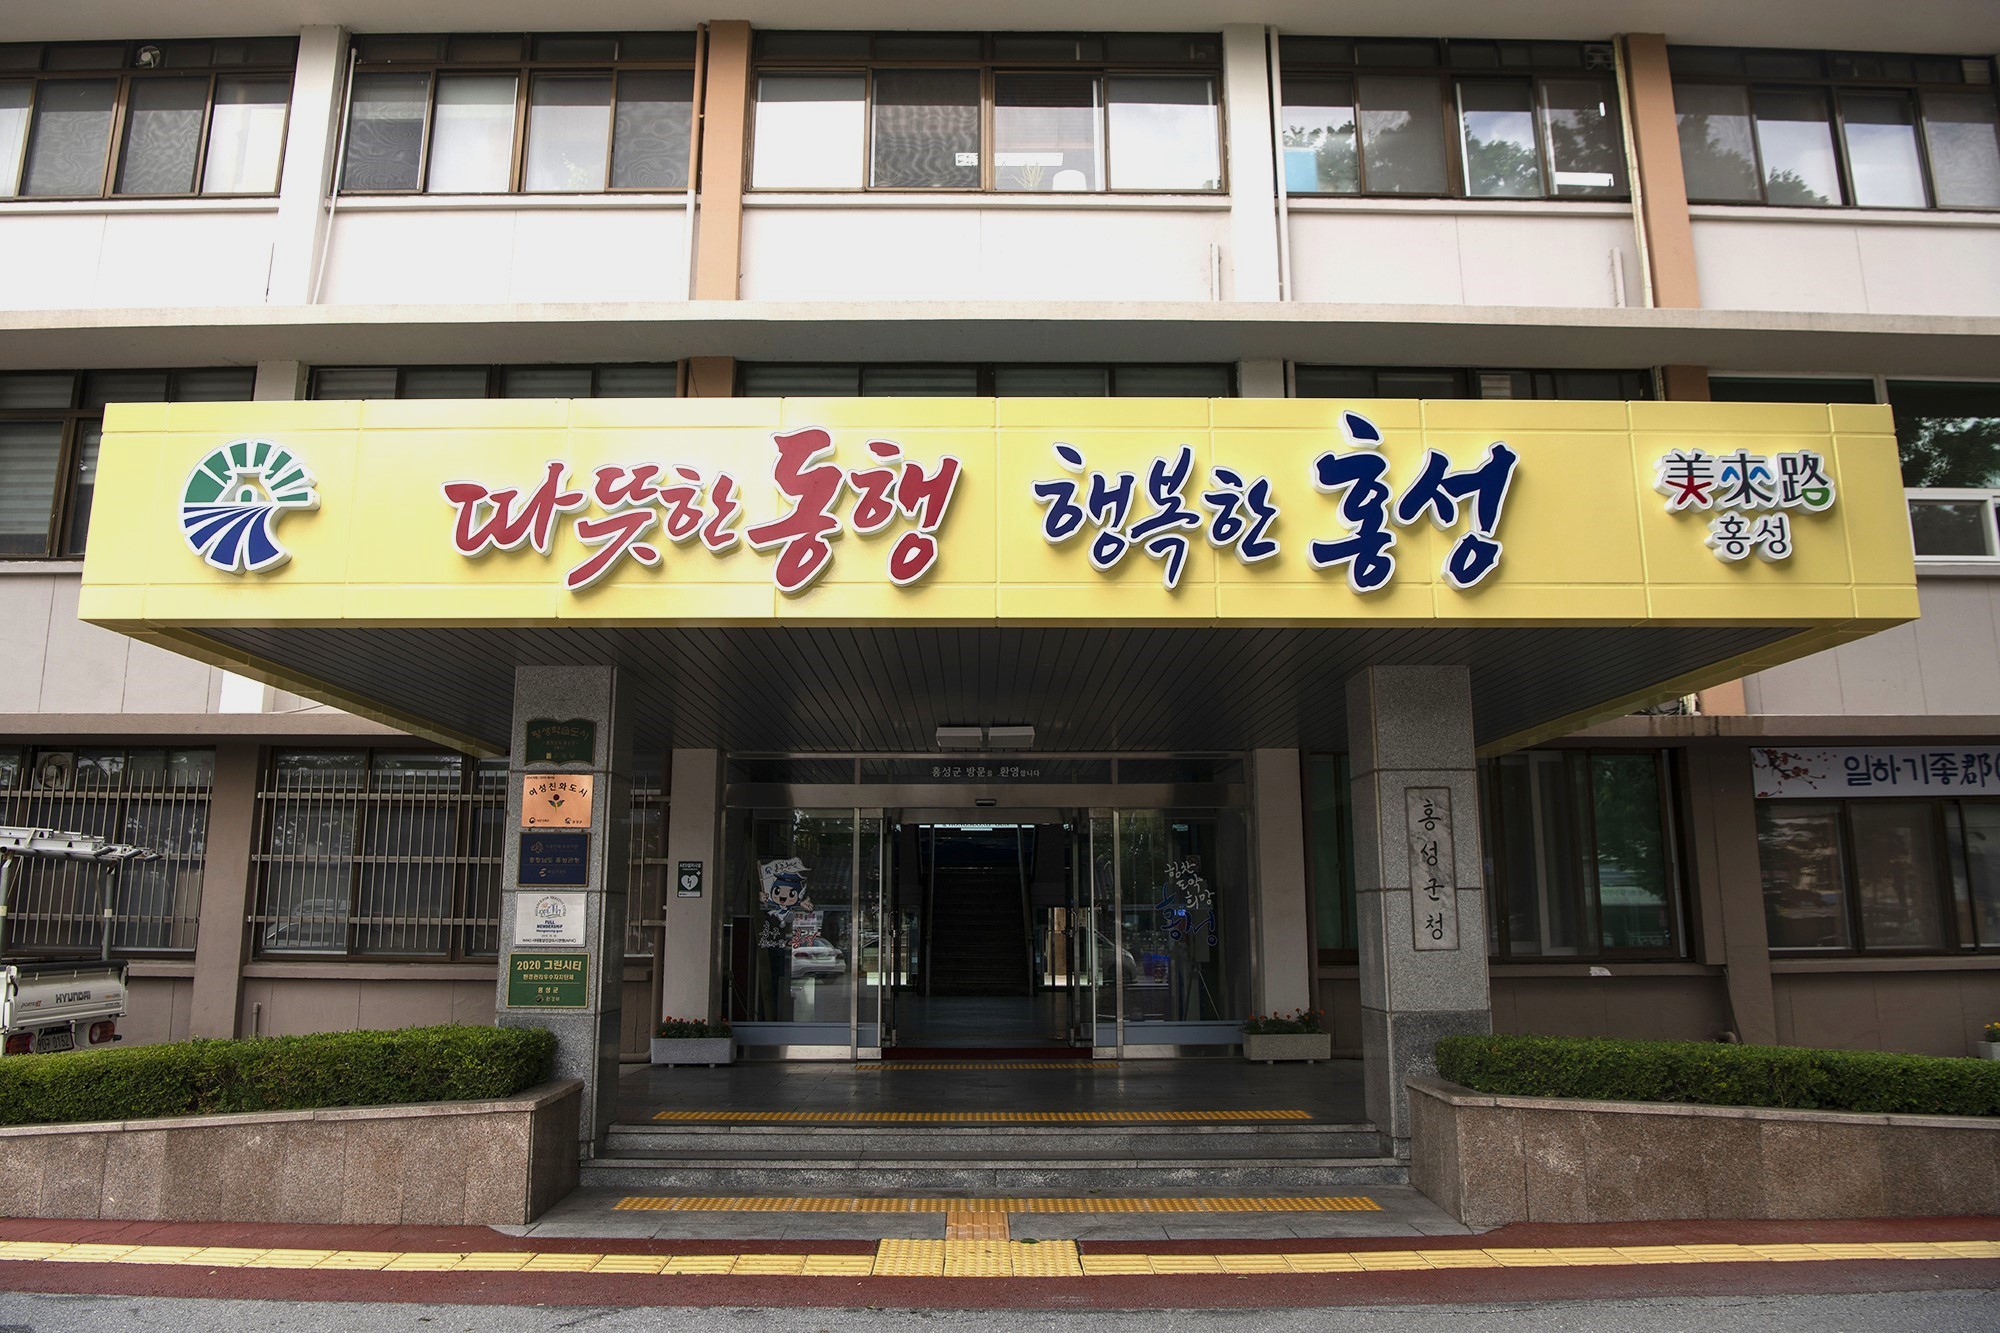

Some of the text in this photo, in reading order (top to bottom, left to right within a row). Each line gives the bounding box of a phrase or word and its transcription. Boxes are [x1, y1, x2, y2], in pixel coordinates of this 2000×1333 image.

[1662, 450, 1834, 509] 美來路
[443, 410, 1519, 594] 따뜻한 동행 행복한 홍성
[1716, 514, 1788, 556] 홍성
[931, 766, 962, 778] 홍성군
[528, 782, 588, 798] 여성친화도시
[1417, 798, 1446, 941] 홍성군청
[1184, 889, 1215, 910] 희망
[516, 960, 582, 971] 2020 그린시티
[56, 990, 91, 1003] HYUNDAI
